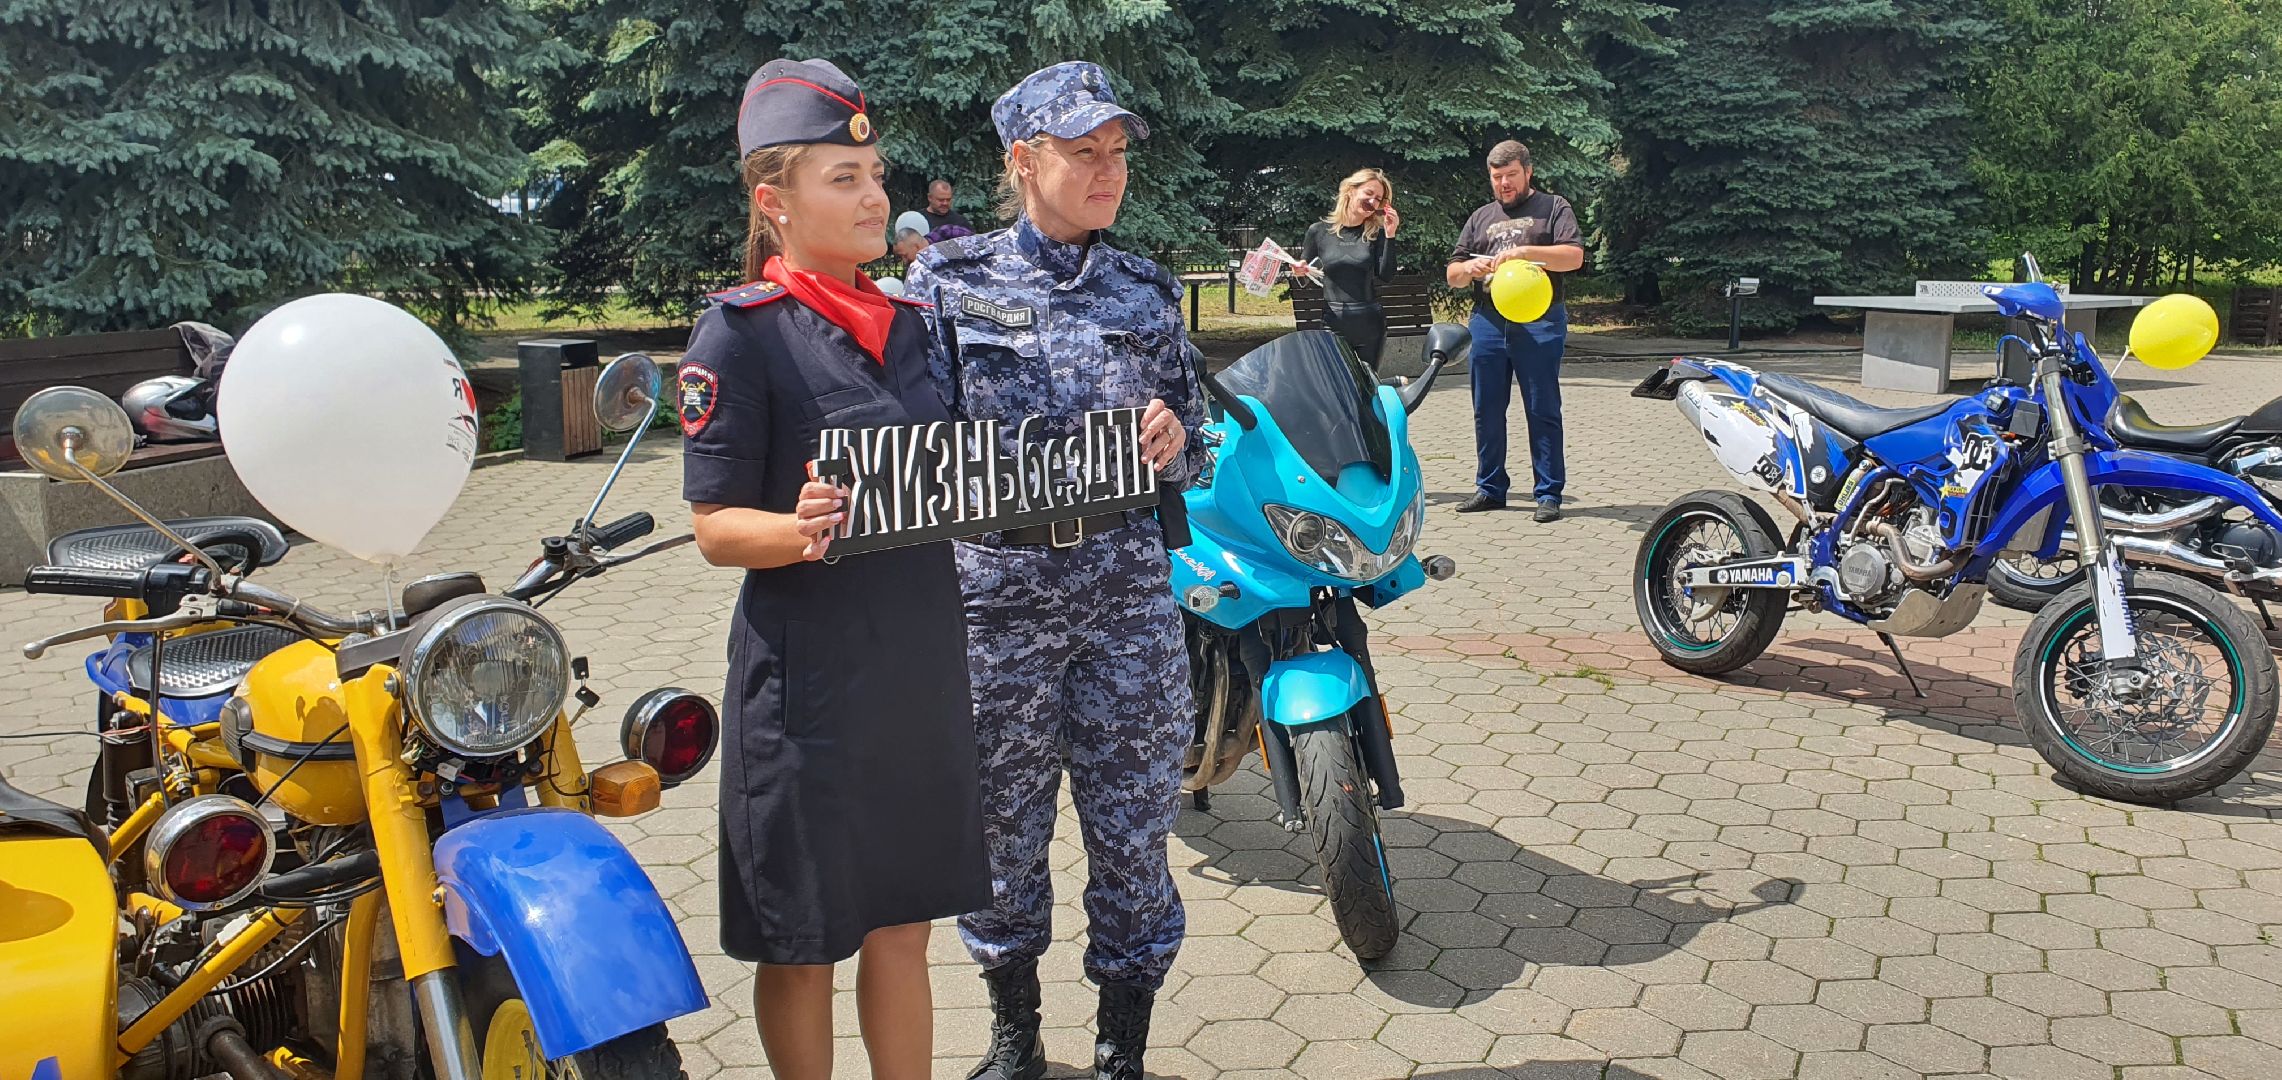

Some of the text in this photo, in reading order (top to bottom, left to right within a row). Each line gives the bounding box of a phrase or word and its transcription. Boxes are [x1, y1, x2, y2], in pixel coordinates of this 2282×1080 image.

[967, 300, 1025, 324] РОСГВАРДИЯ
[1729, 567, 1773, 583] YAMAHA
[1848, 566, 1872, 578] YAMAHA
